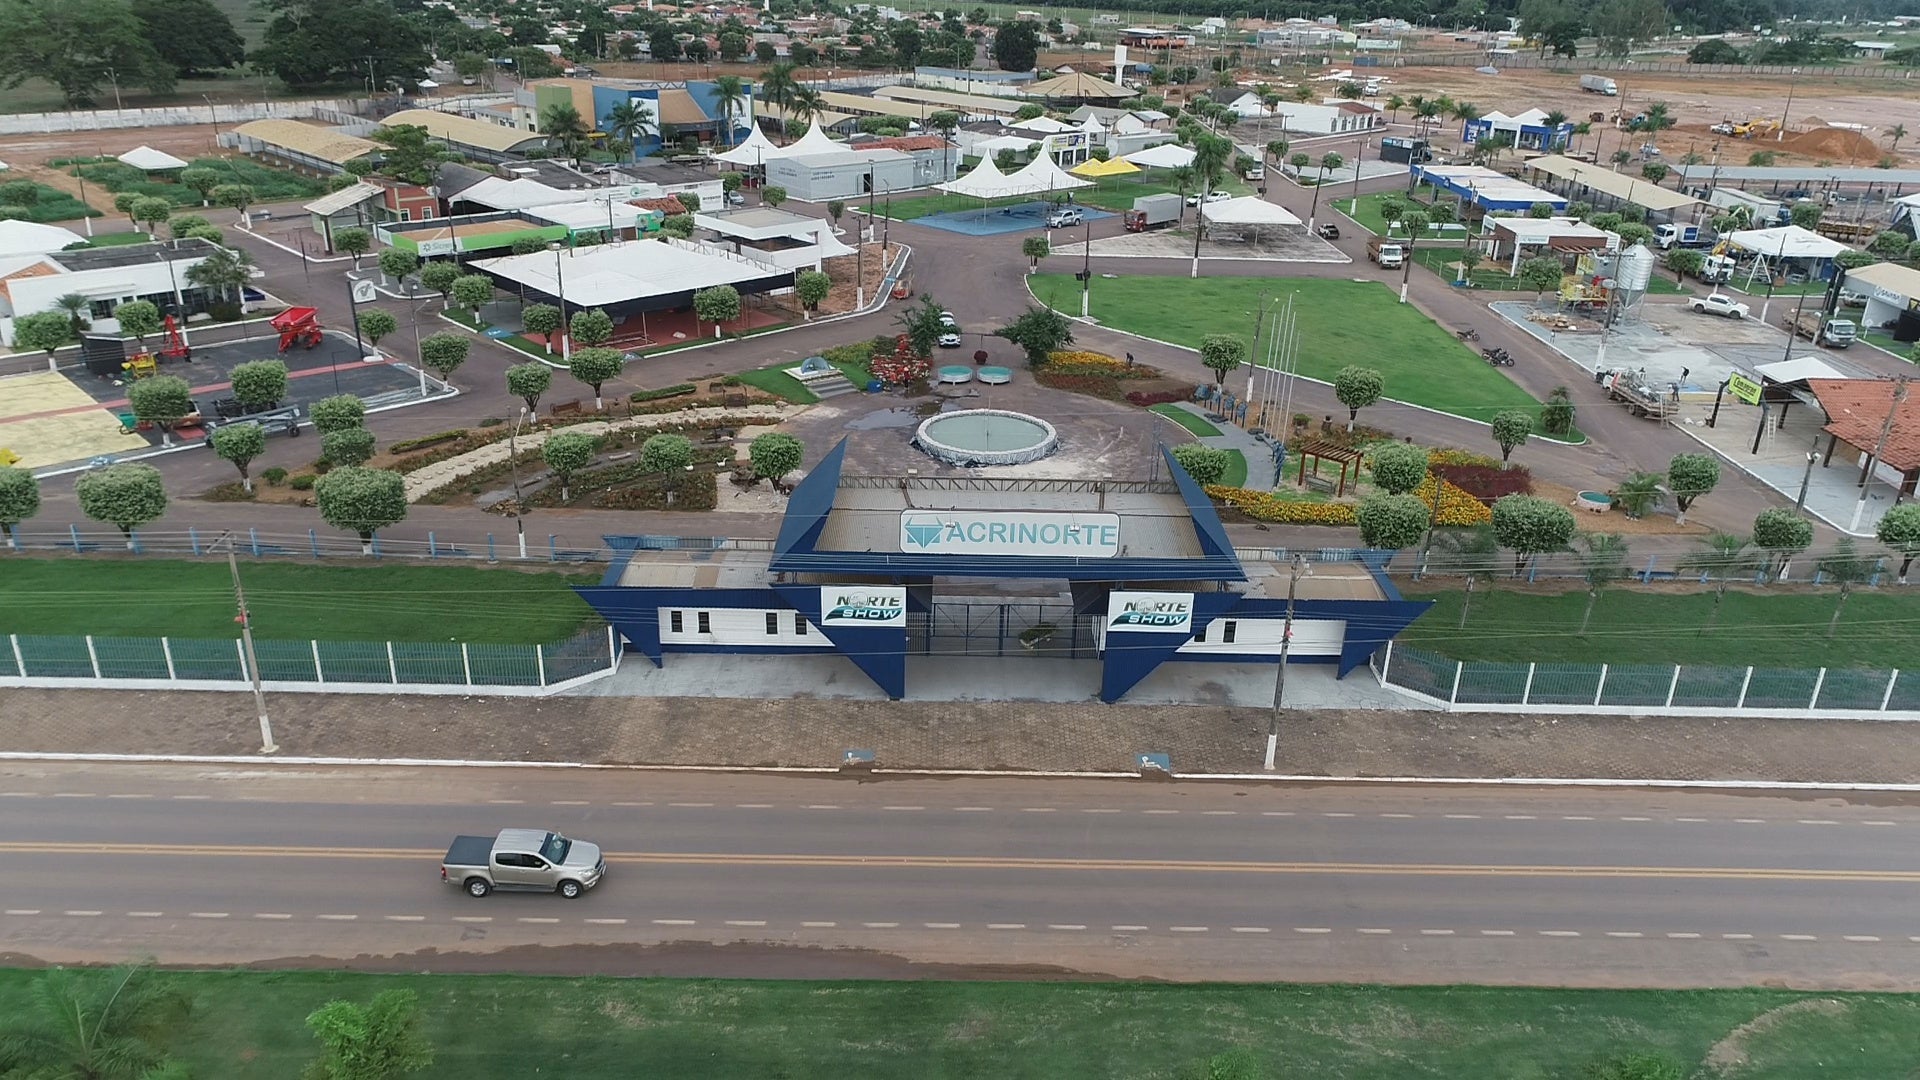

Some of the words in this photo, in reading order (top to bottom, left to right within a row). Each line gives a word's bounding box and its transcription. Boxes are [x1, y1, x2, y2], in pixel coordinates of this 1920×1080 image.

[946, 521, 1117, 546] ACRINORTE
[842, 609, 898, 618] SHOW
[1128, 615, 1185, 623] SHOW
